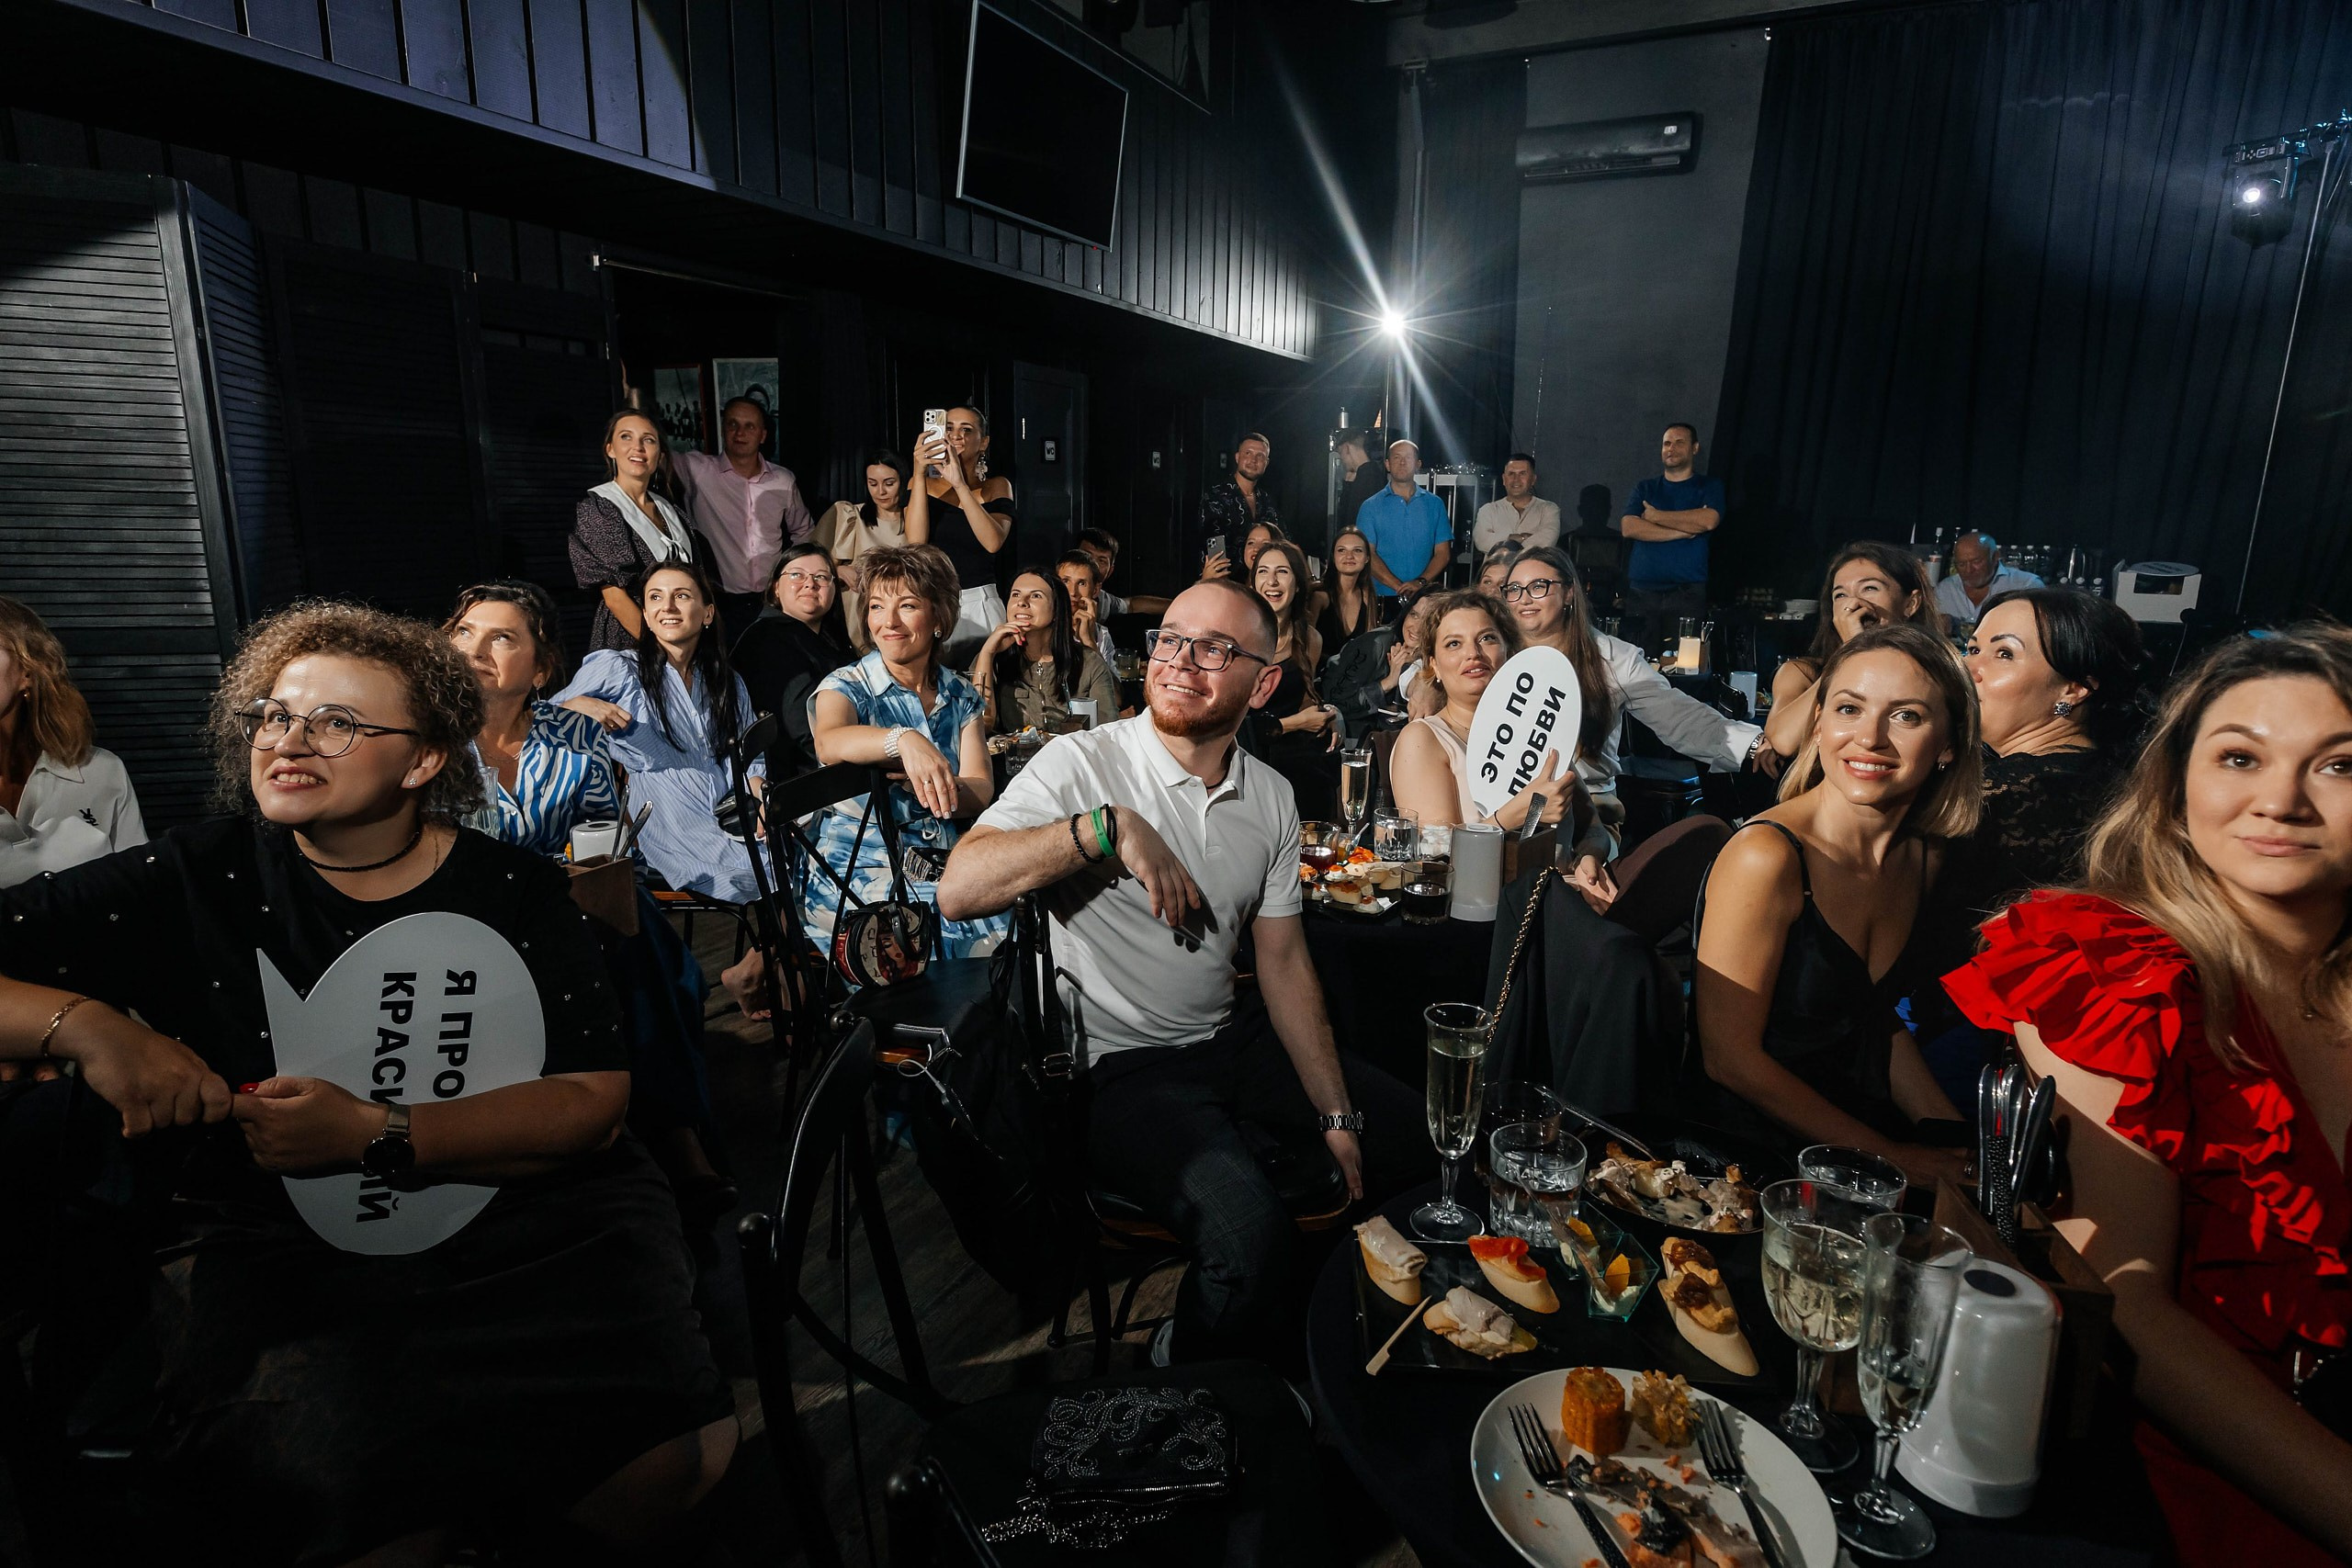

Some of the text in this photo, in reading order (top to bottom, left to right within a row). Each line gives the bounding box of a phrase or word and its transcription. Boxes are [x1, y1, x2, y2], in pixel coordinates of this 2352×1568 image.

[1480, 671, 1534, 784] ЭТО ПО
[1508, 685, 1566, 797] ЛЮБВИ
[432, 968, 478, 1099] Я ПРО
